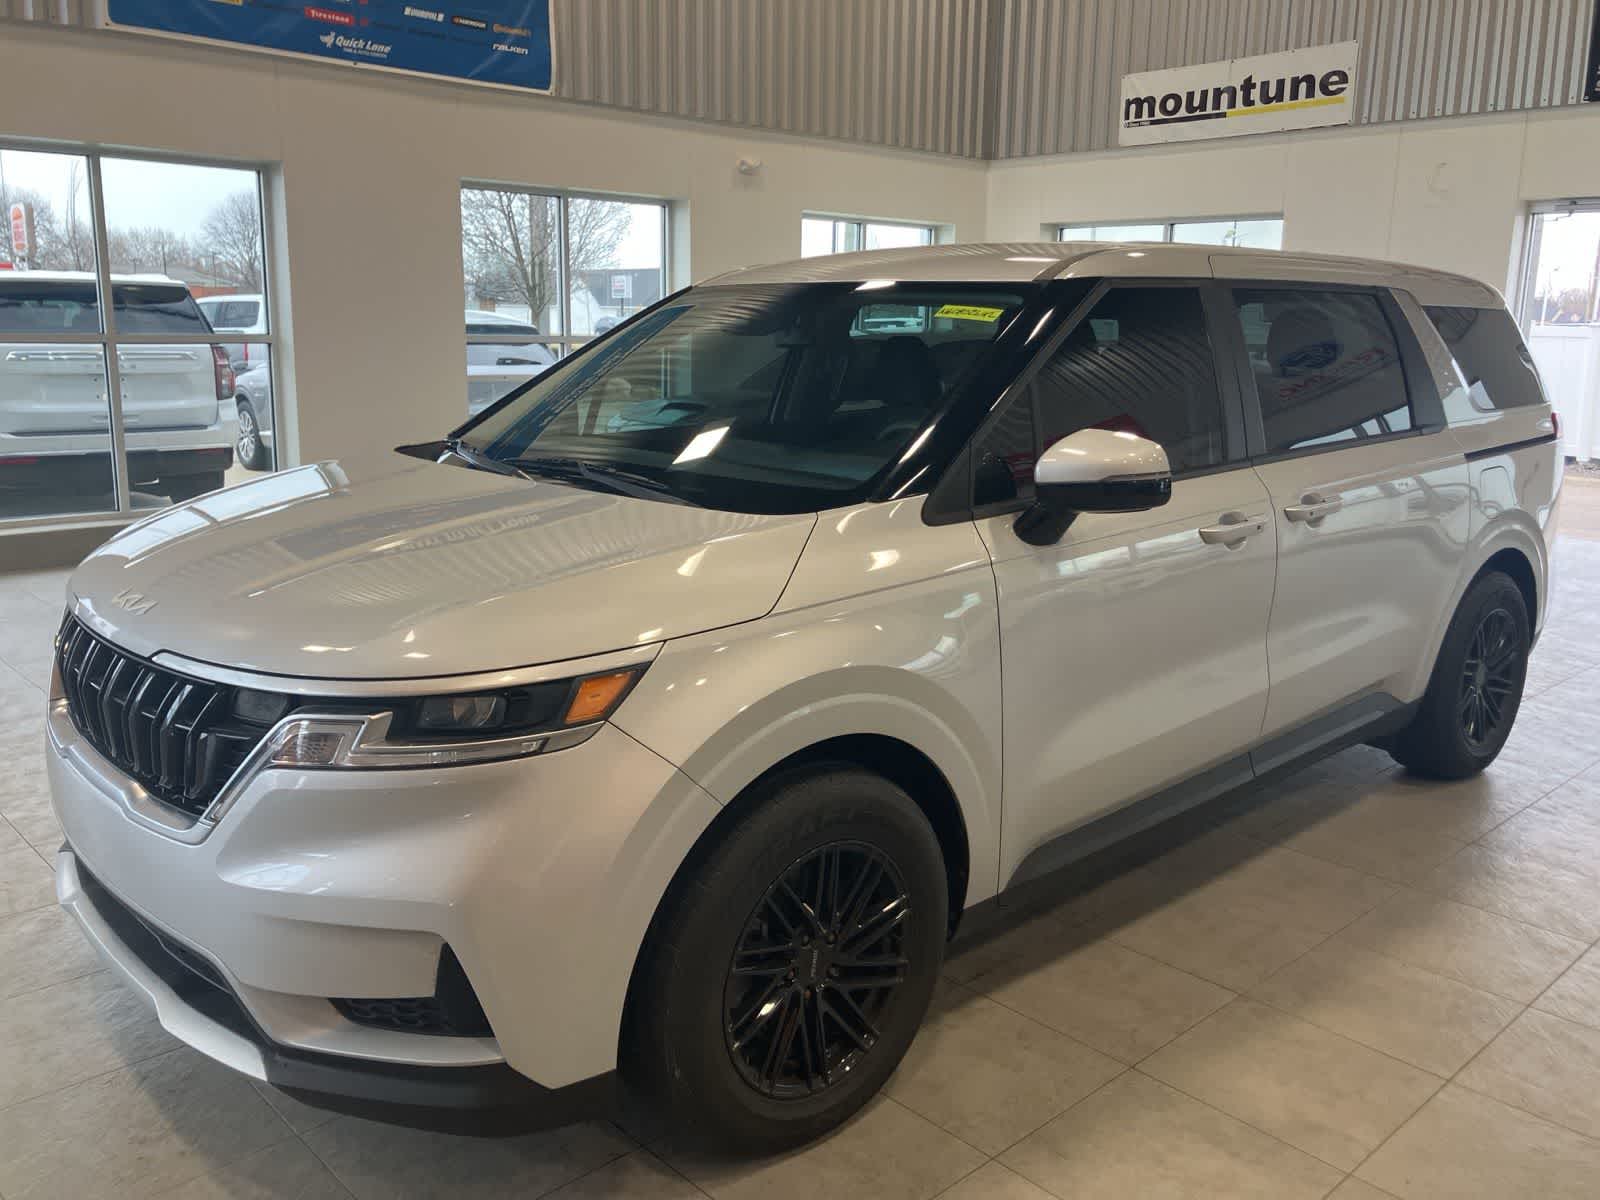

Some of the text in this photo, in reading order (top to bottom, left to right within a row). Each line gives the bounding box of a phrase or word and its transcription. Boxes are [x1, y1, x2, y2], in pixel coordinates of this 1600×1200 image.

[335, 36, 366, 49] Quick
[366, 40, 392, 54] Lane
[1124, 69, 1348, 120] mountune
